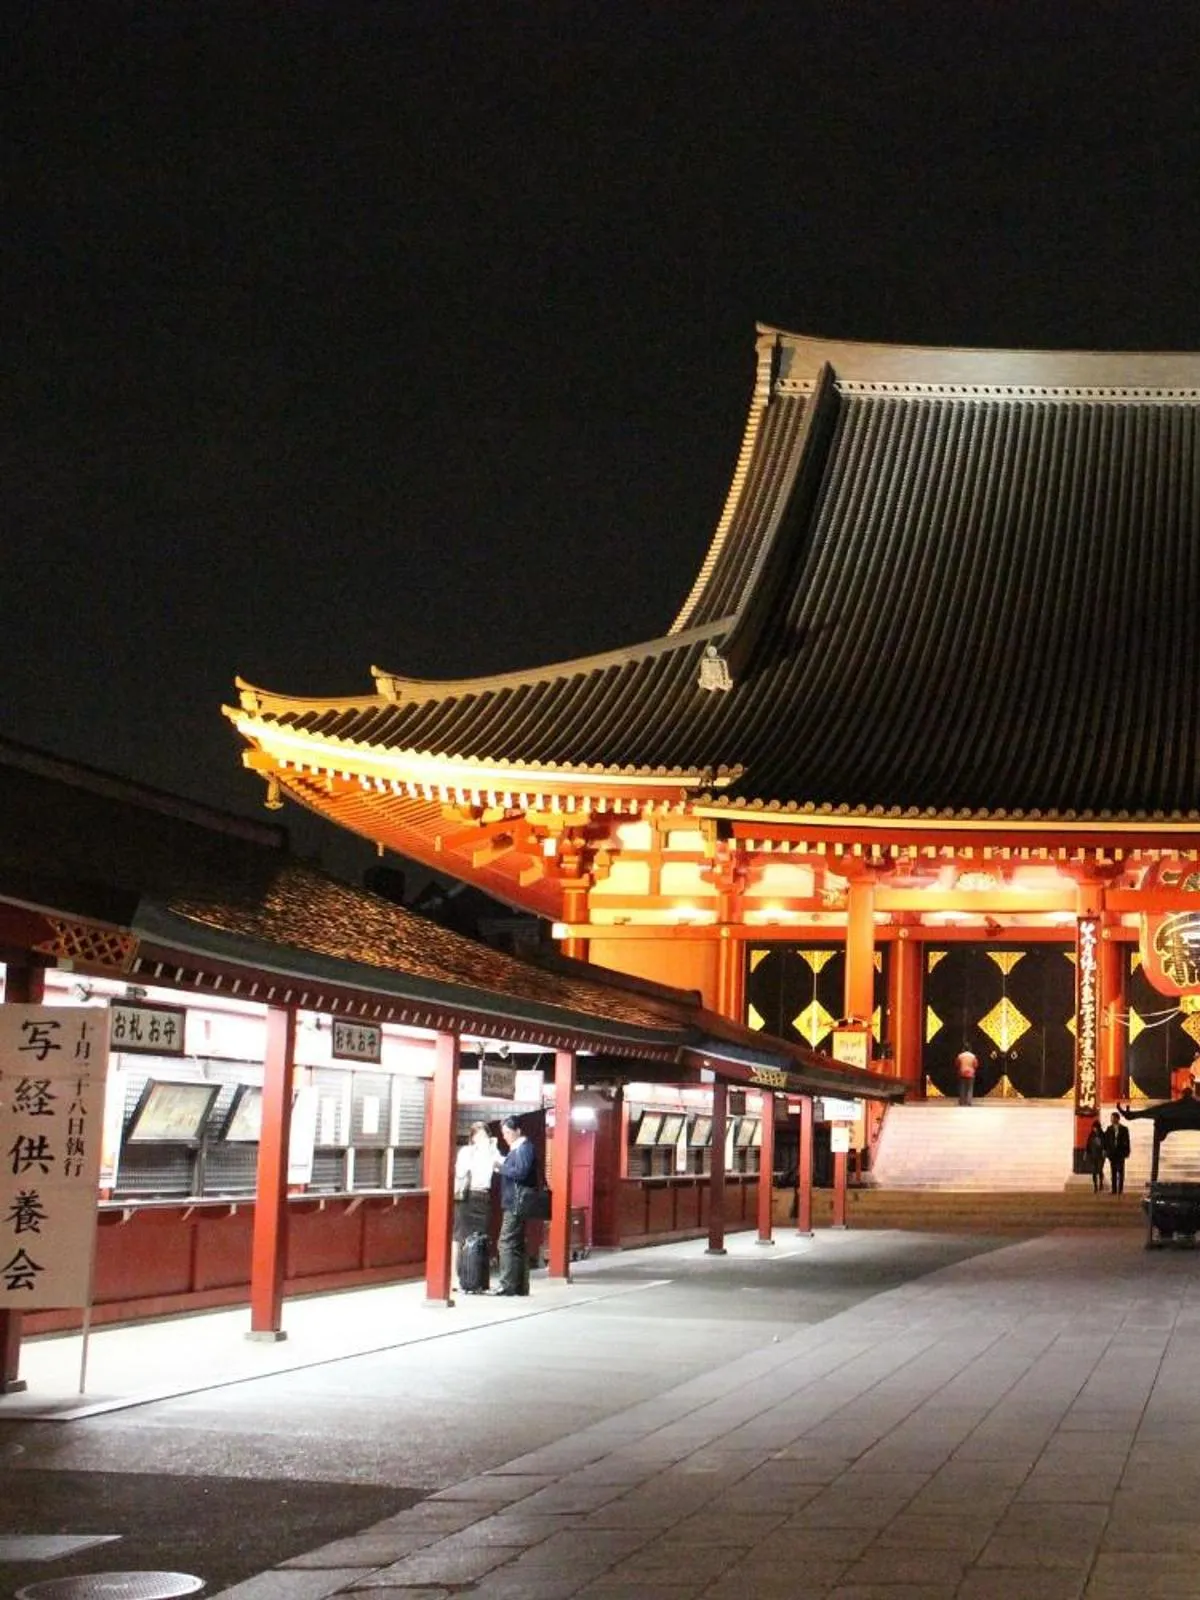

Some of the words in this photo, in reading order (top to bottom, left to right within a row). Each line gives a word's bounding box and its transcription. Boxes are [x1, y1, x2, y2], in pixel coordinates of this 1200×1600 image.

[0, 1020, 62, 1292] 写経供養会
